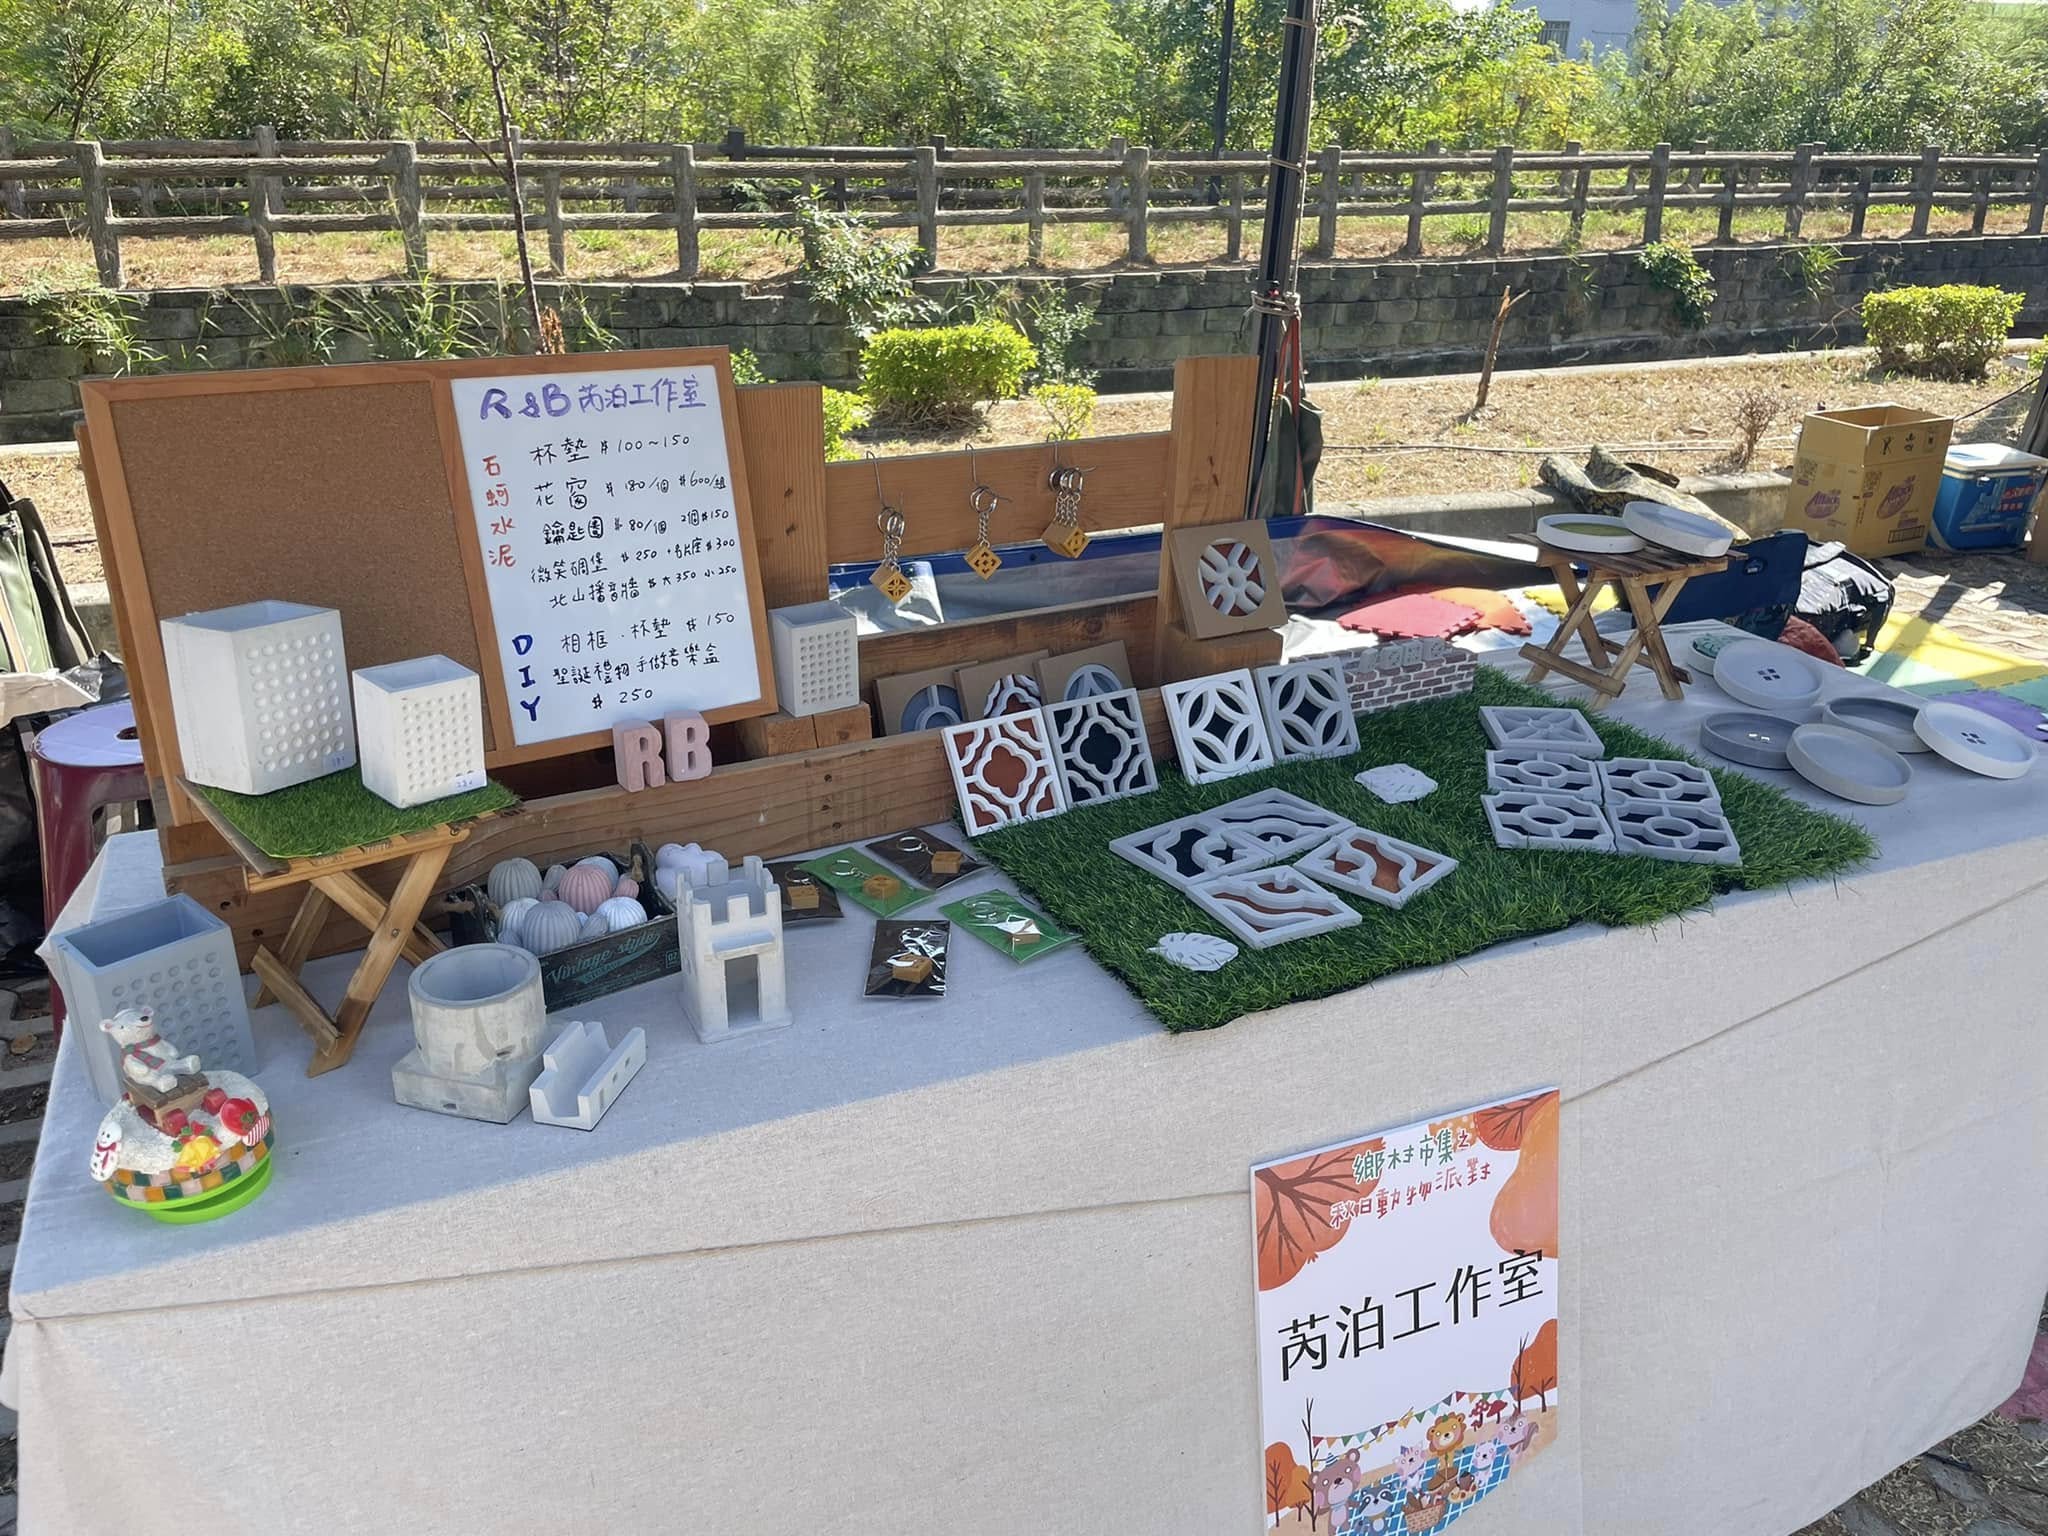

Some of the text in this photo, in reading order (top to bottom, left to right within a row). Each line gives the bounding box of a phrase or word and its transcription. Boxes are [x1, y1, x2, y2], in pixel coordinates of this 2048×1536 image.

[530, 437, 590, 466] 杯墊
[534, 477, 588, 510] 花窗
[511, 634, 541, 722] DIY
[1278, 1249, 1543, 1382] 芮泊工作室
